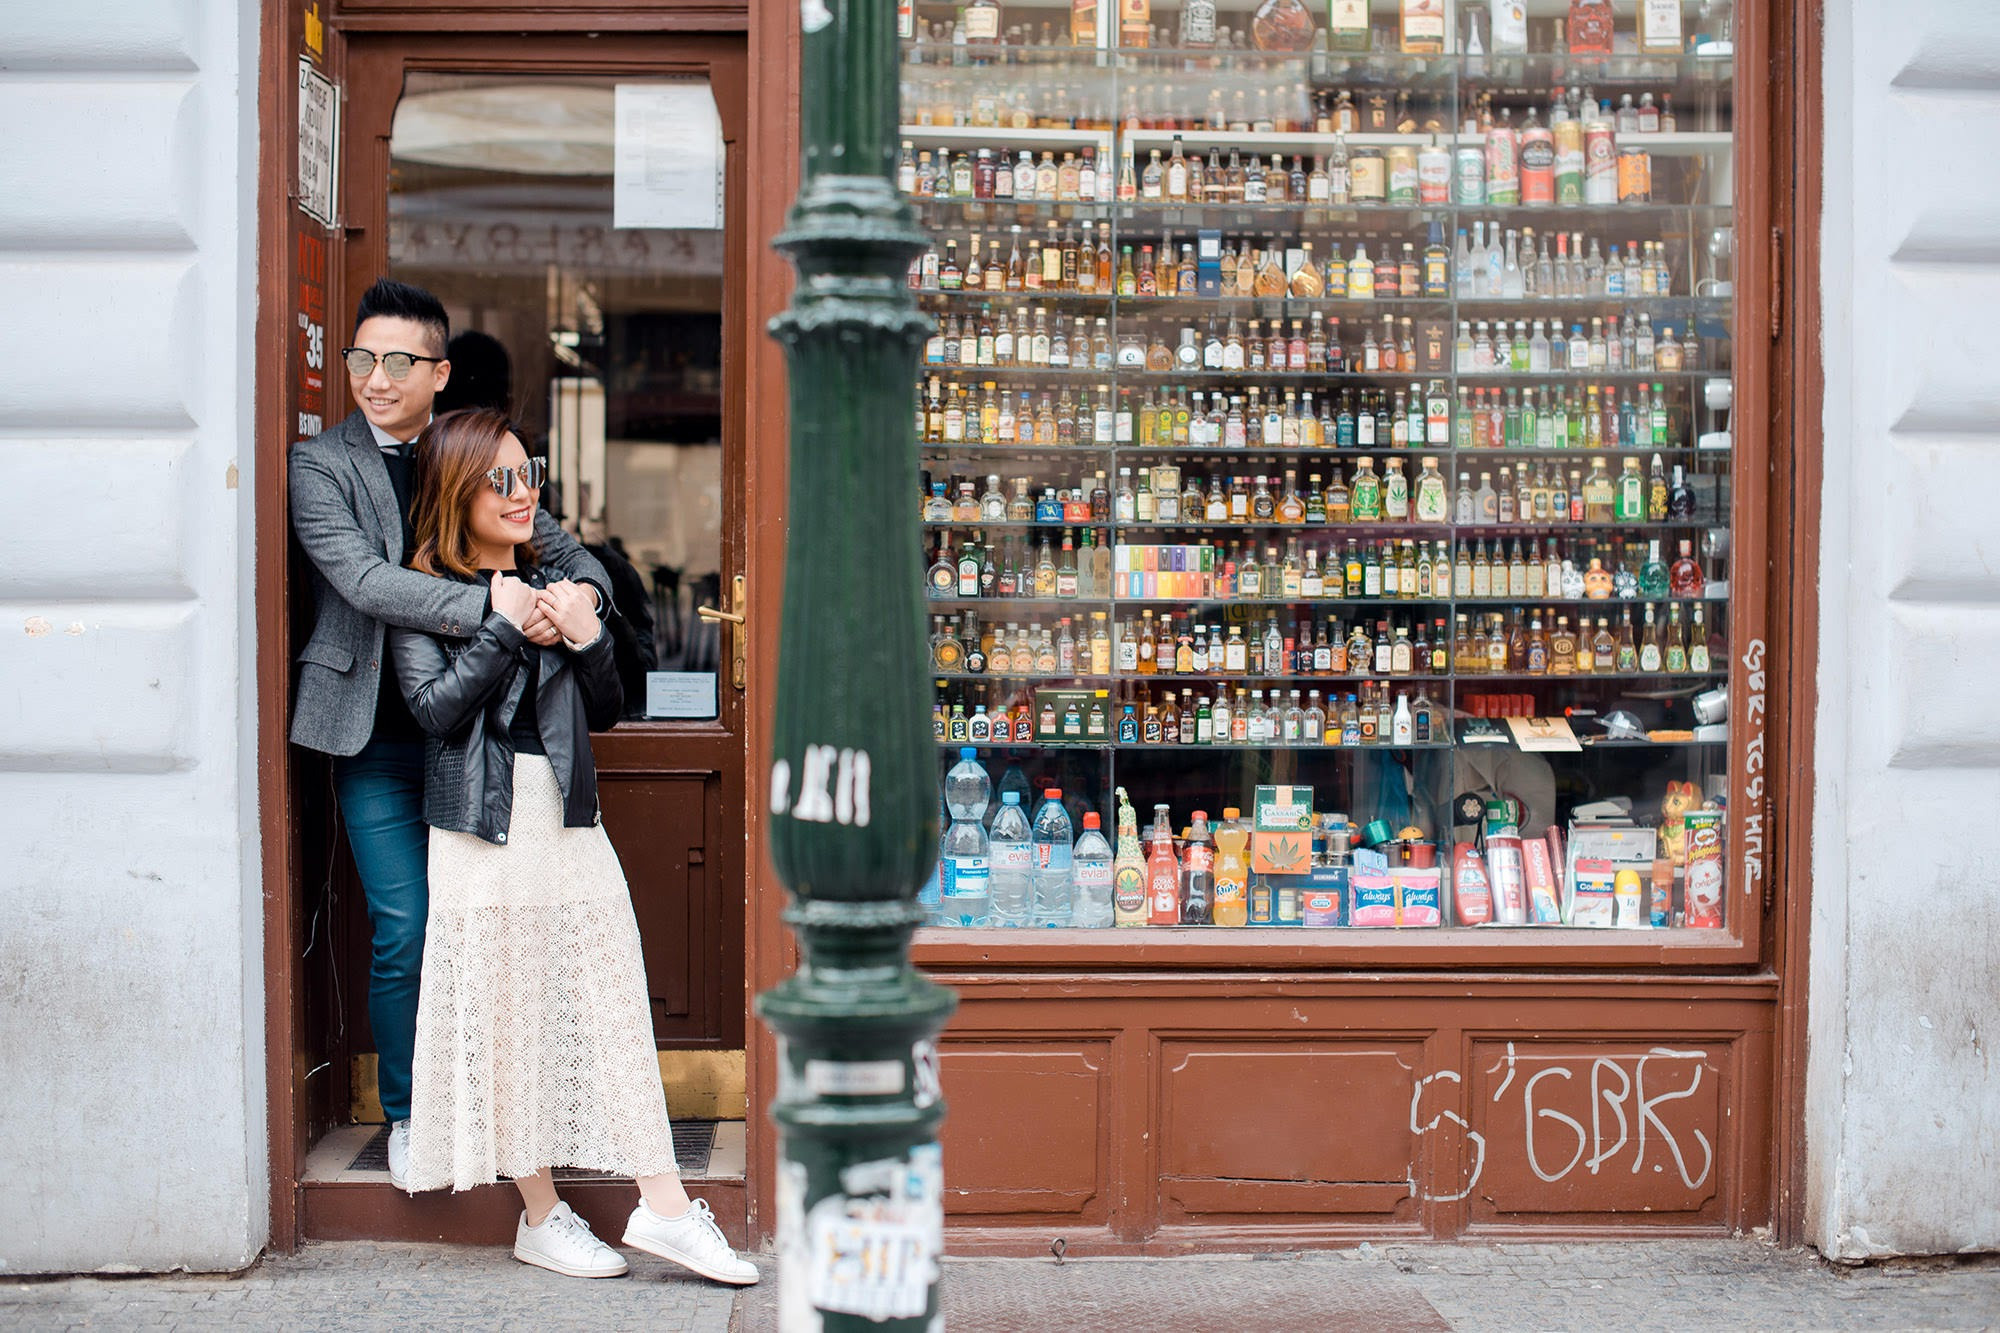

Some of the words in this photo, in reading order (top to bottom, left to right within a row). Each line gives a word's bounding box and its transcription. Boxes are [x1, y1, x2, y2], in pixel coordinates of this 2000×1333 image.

[306, 323, 323, 370] 35
[1080, 867, 1109, 879] evian
[1362, 890, 1392, 903] always
[1405, 890, 1435, 904] always
